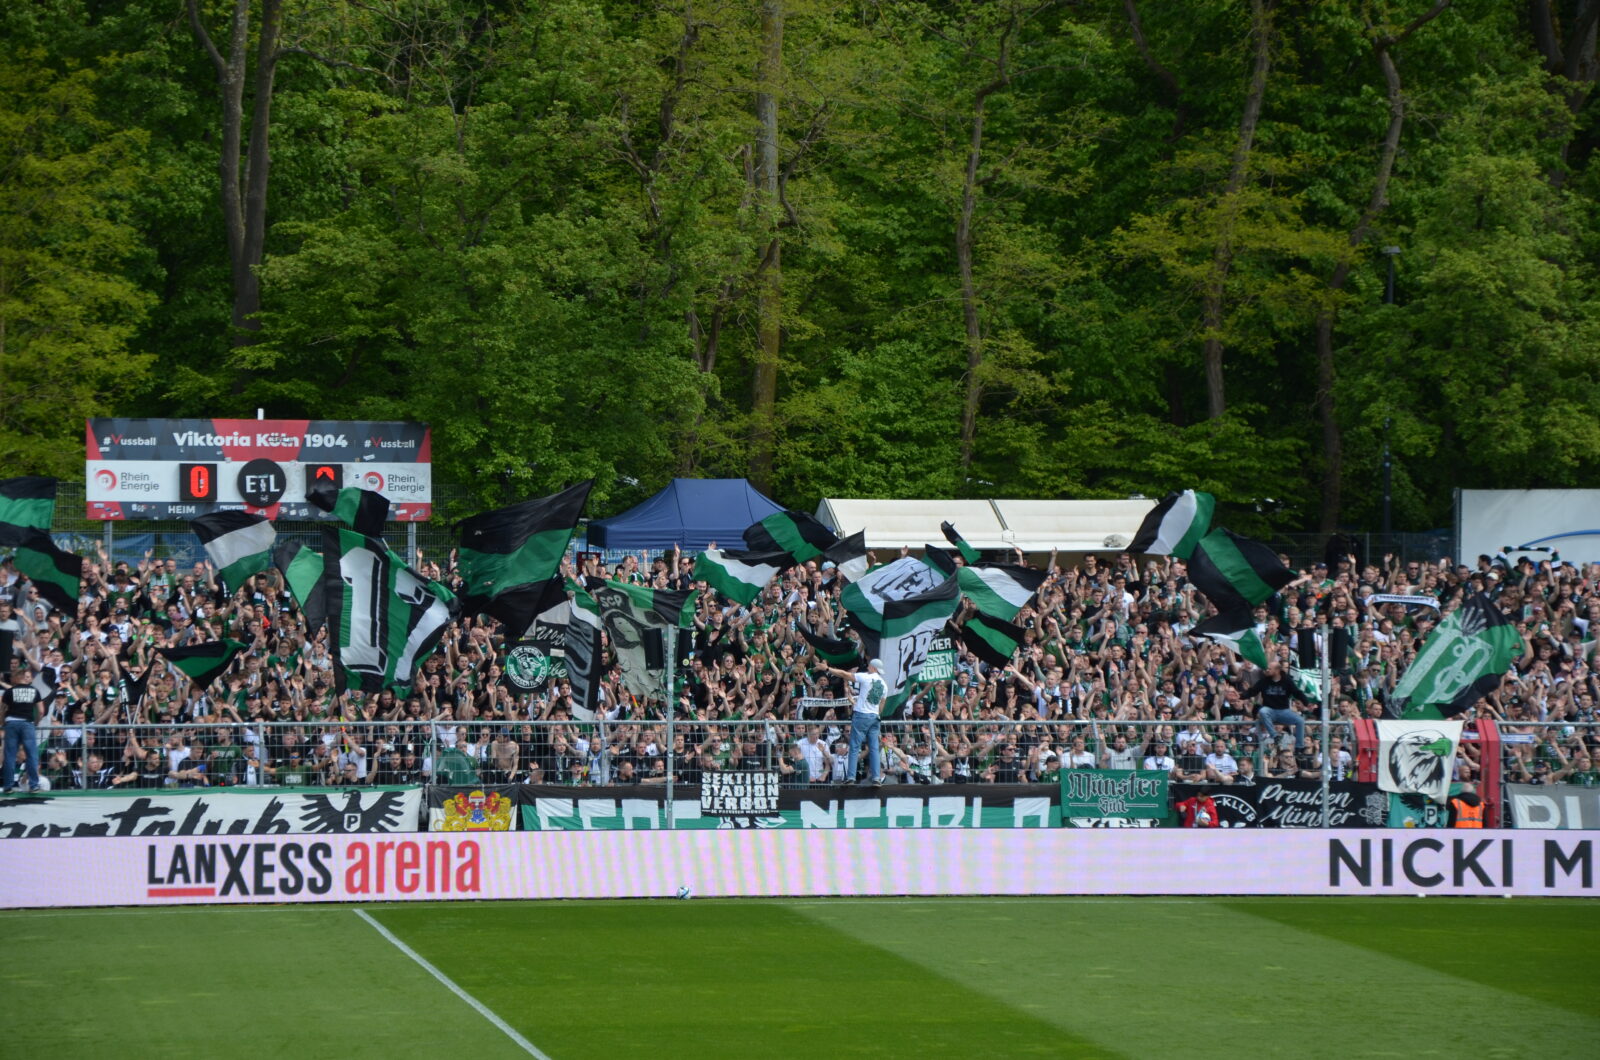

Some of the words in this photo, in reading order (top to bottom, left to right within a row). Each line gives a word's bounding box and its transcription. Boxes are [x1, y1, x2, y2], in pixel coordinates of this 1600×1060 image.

[103, 434, 156, 446] #Vussball
[173, 432, 251, 447] Viktoria
[256, 432, 299, 447] Köln
[304, 434, 348, 448] 1904
[121, 473, 149, 481] Rhein
[190, 466, 209, 498] 0
[246, 474, 279, 493] ETL
[388, 474, 415, 482] Rhein
[121, 482, 159, 492] Energie
[388, 484, 424, 493] Energie
[168, 505, 195, 514] HEIM
[702, 772, 779, 785] SEKTION
[701, 784, 779, 797] STADION
[1067, 771, 1161, 801] Münster
[701, 796, 778, 810] VERBOT
[1260, 805, 1356, 827] Münster
[148, 842, 332, 896] LANXESS
[345, 841, 481, 894] arena
[1329, 838, 1513, 888] NICKI
[1545, 839, 1593, 888] M
